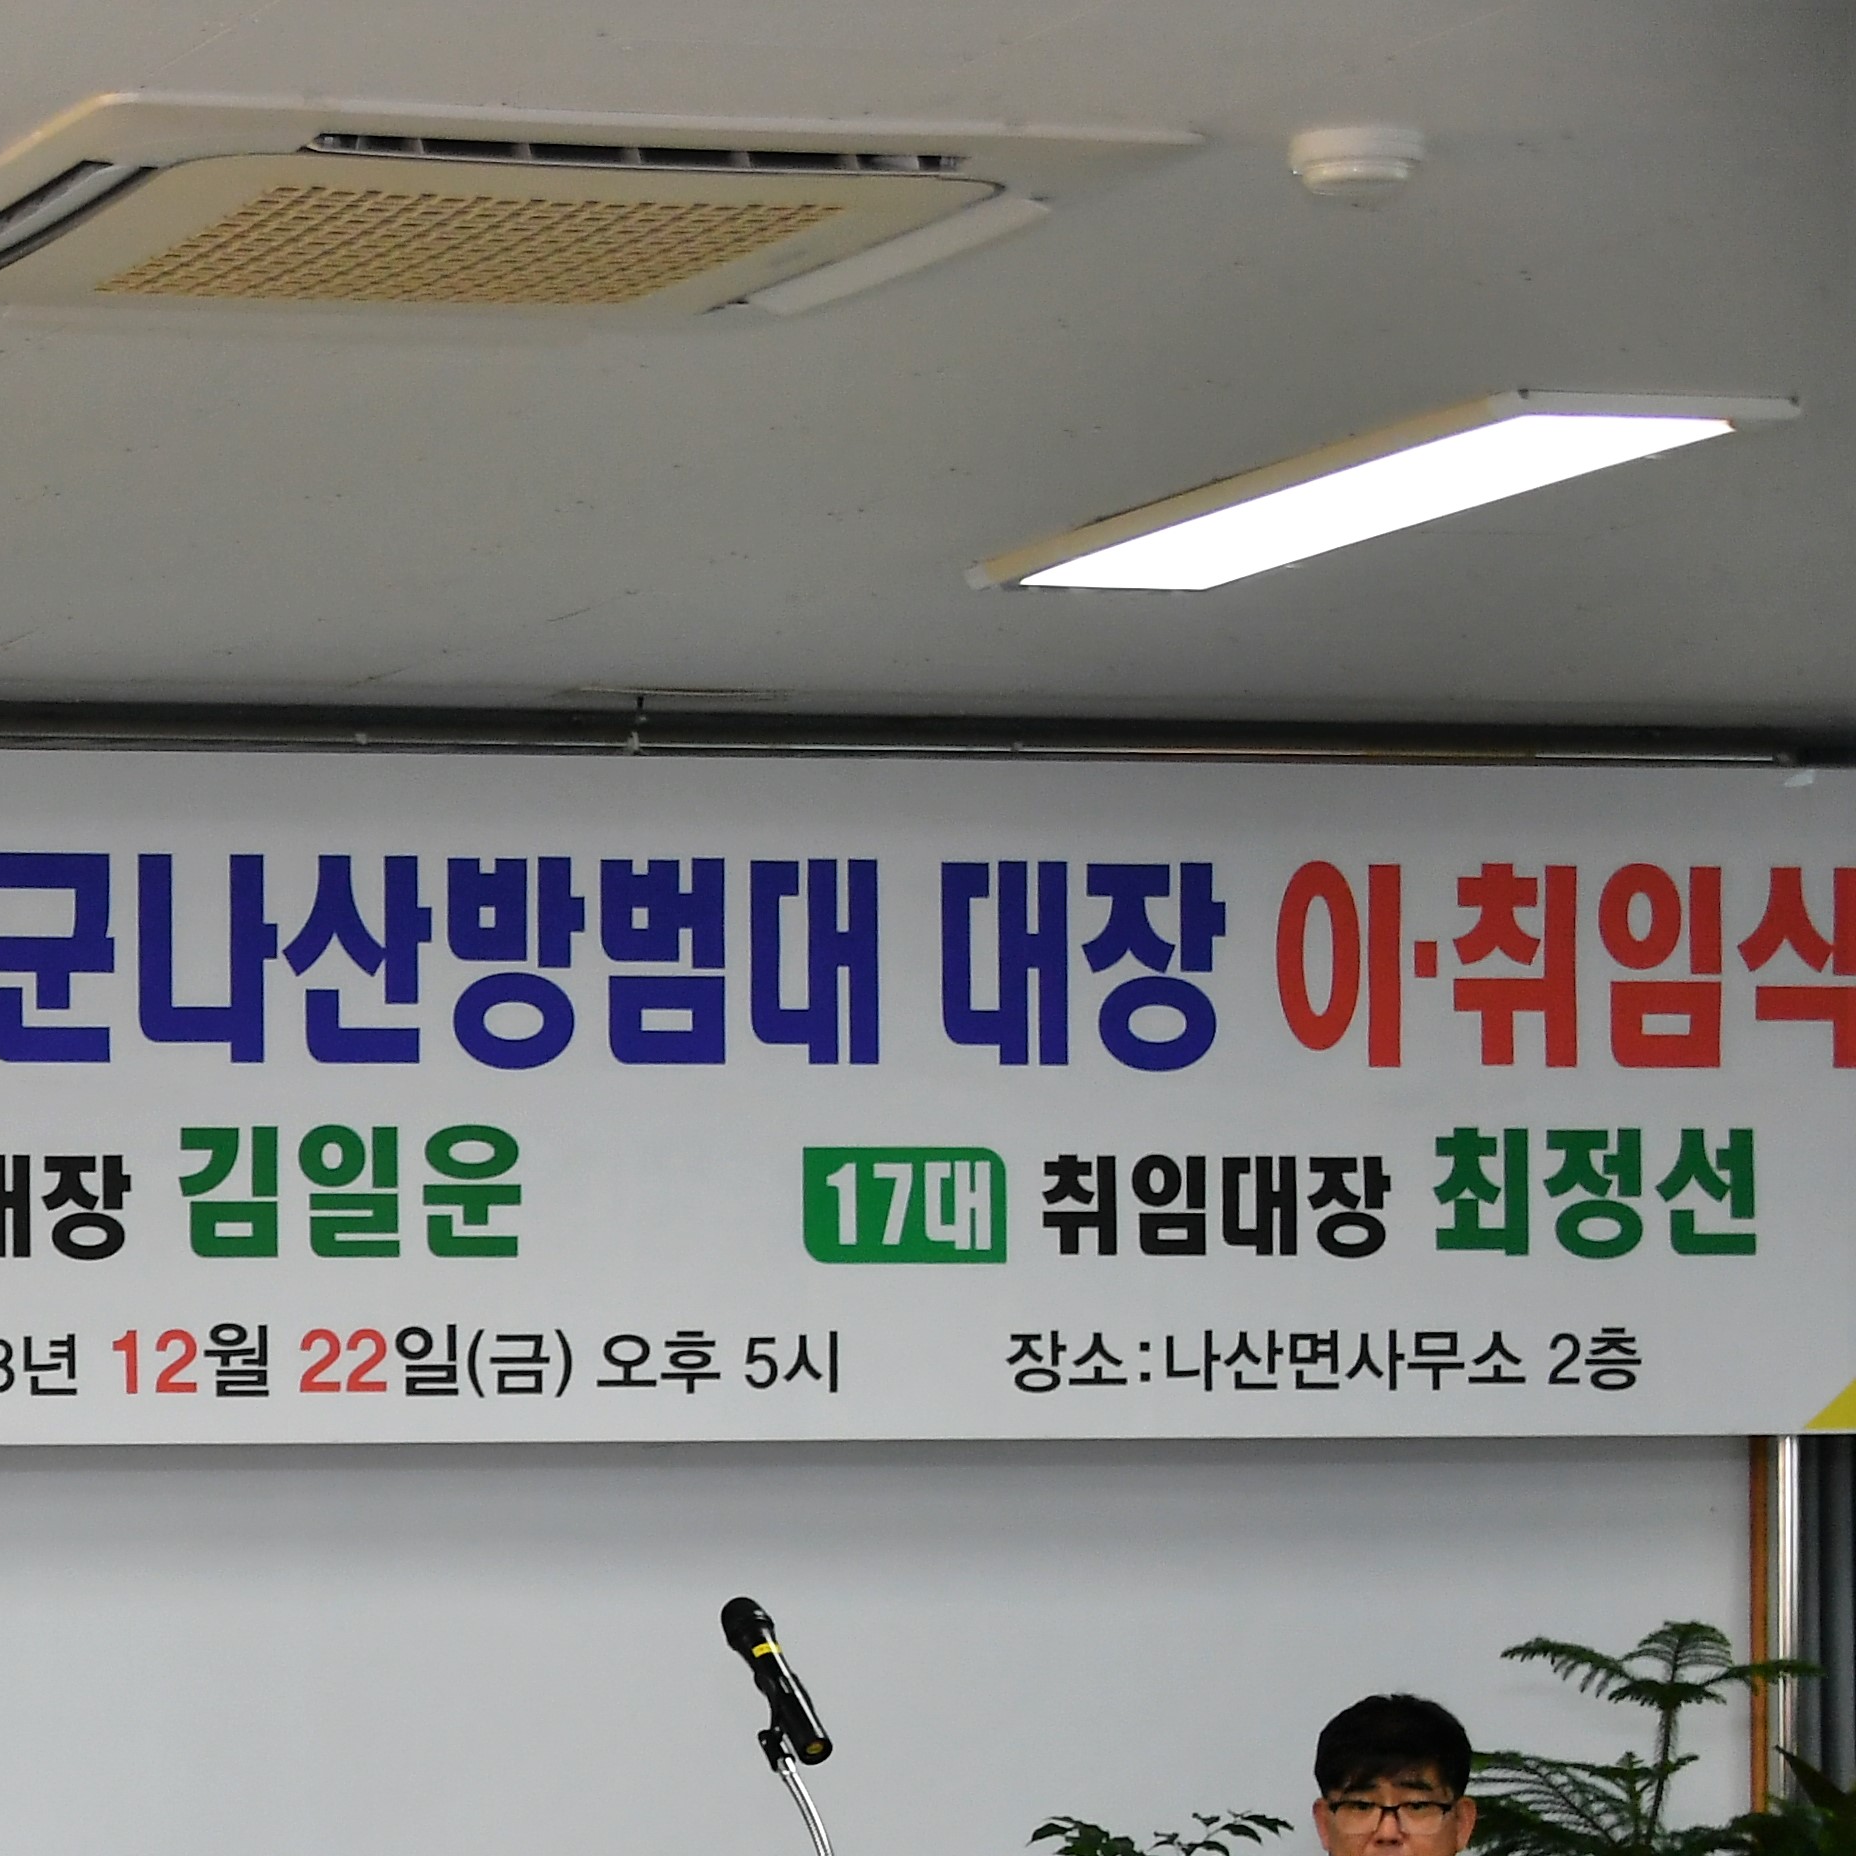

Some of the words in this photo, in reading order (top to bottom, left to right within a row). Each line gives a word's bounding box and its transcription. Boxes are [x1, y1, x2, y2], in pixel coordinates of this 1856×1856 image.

[939, 858, 1226, 1072] 대장
[1276, 859, 1856, 1069] 이·취임식
[178, 1122, 524, 1262] 김일운
[823, 1156, 995, 1254] 17대
[1040, 1153, 1392, 1261] 취임대장
[1432, 1125, 1758, 1260] 최정선
[112, 1324, 271, 1398] 12월
[298, 1324, 574, 1400] 22일(금)
[595, 1326, 723, 1396] 오후
[742, 1330, 844, 1398] 5시
[1005, 1326, 1526, 1396] 장소:나산면사무소
[1547, 1326, 1644, 1394] 2층
